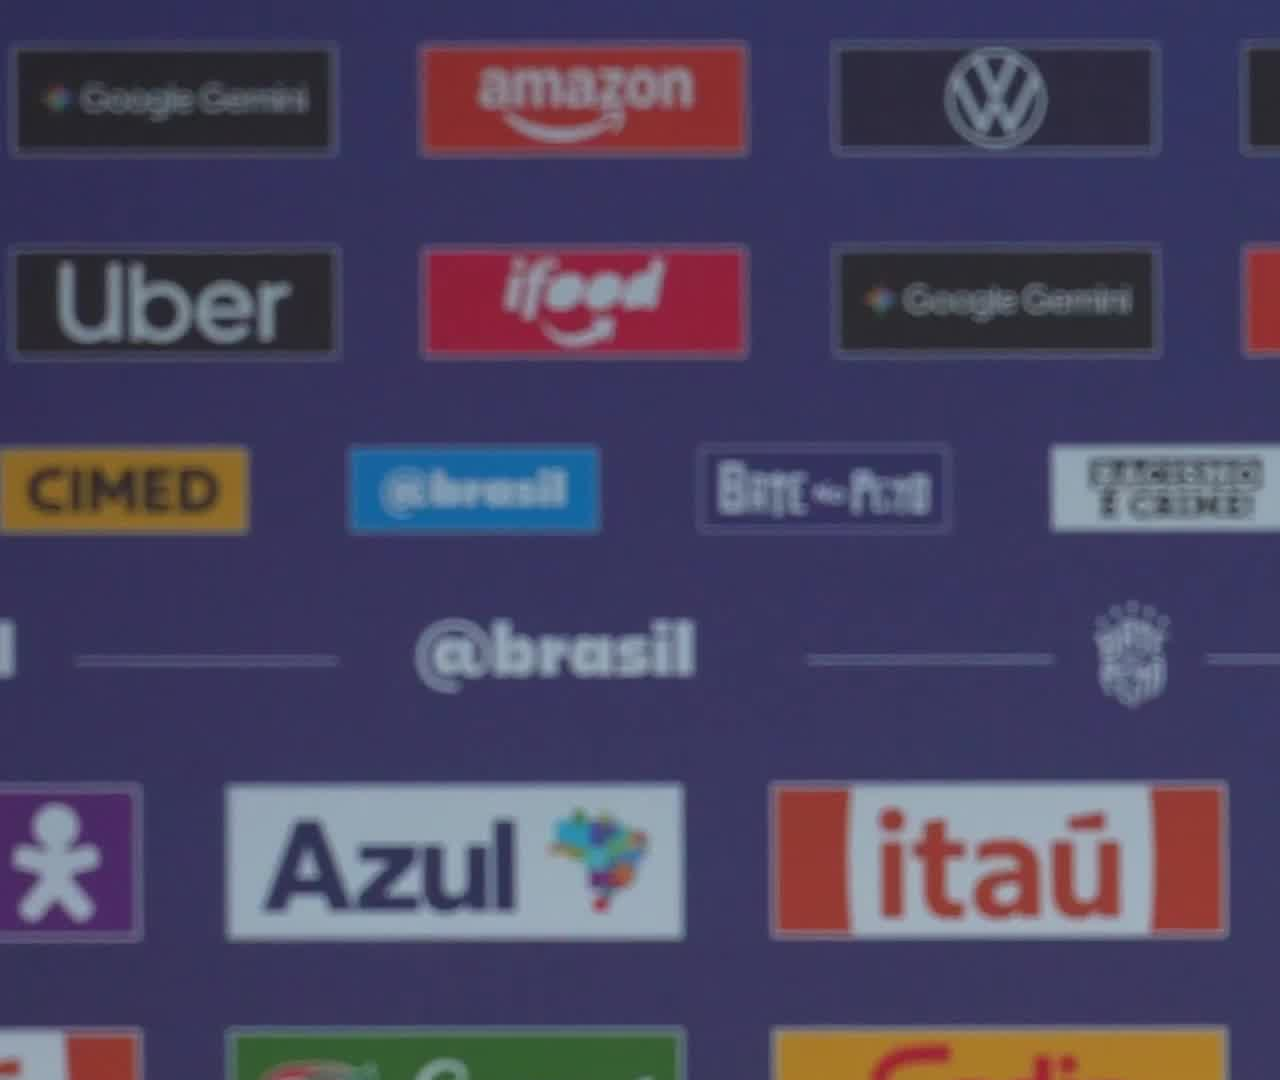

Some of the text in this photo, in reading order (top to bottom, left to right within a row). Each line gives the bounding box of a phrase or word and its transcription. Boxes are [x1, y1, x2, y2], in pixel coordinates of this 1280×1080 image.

[81, 83, 310, 122] Google Gemini
[478, 65, 694, 110] amazon
[59, 263, 292, 344] Uber
[506, 258, 666, 324] ifood
[903, 284, 1134, 323] Google Gemini
[27, 467, 221, 515] CIMED
[383, 469, 569, 514] @brasil
[417, 620, 696, 693] @brasil
[265, 821, 517, 914] Azul
[881, 809, 1121, 920] itaú
